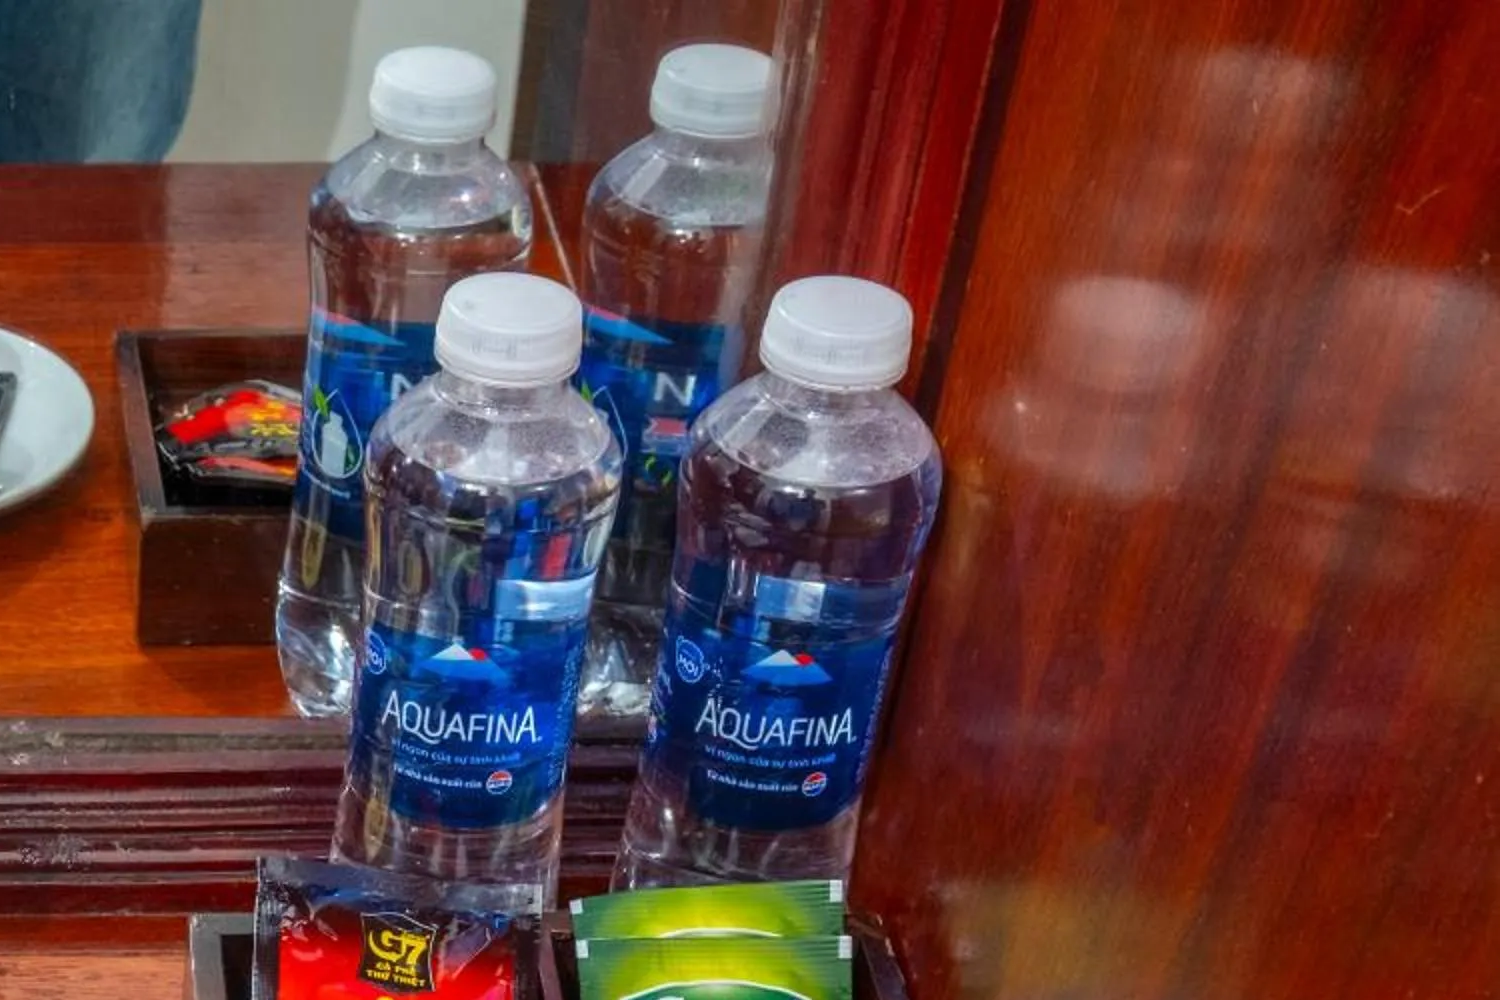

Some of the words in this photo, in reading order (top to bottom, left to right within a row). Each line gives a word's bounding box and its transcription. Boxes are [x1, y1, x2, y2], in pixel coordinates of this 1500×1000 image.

[381, 690, 536, 744] AQUAFINA
[695, 698, 852, 750] AQUAFINA
[368, 929, 426, 965] G7
